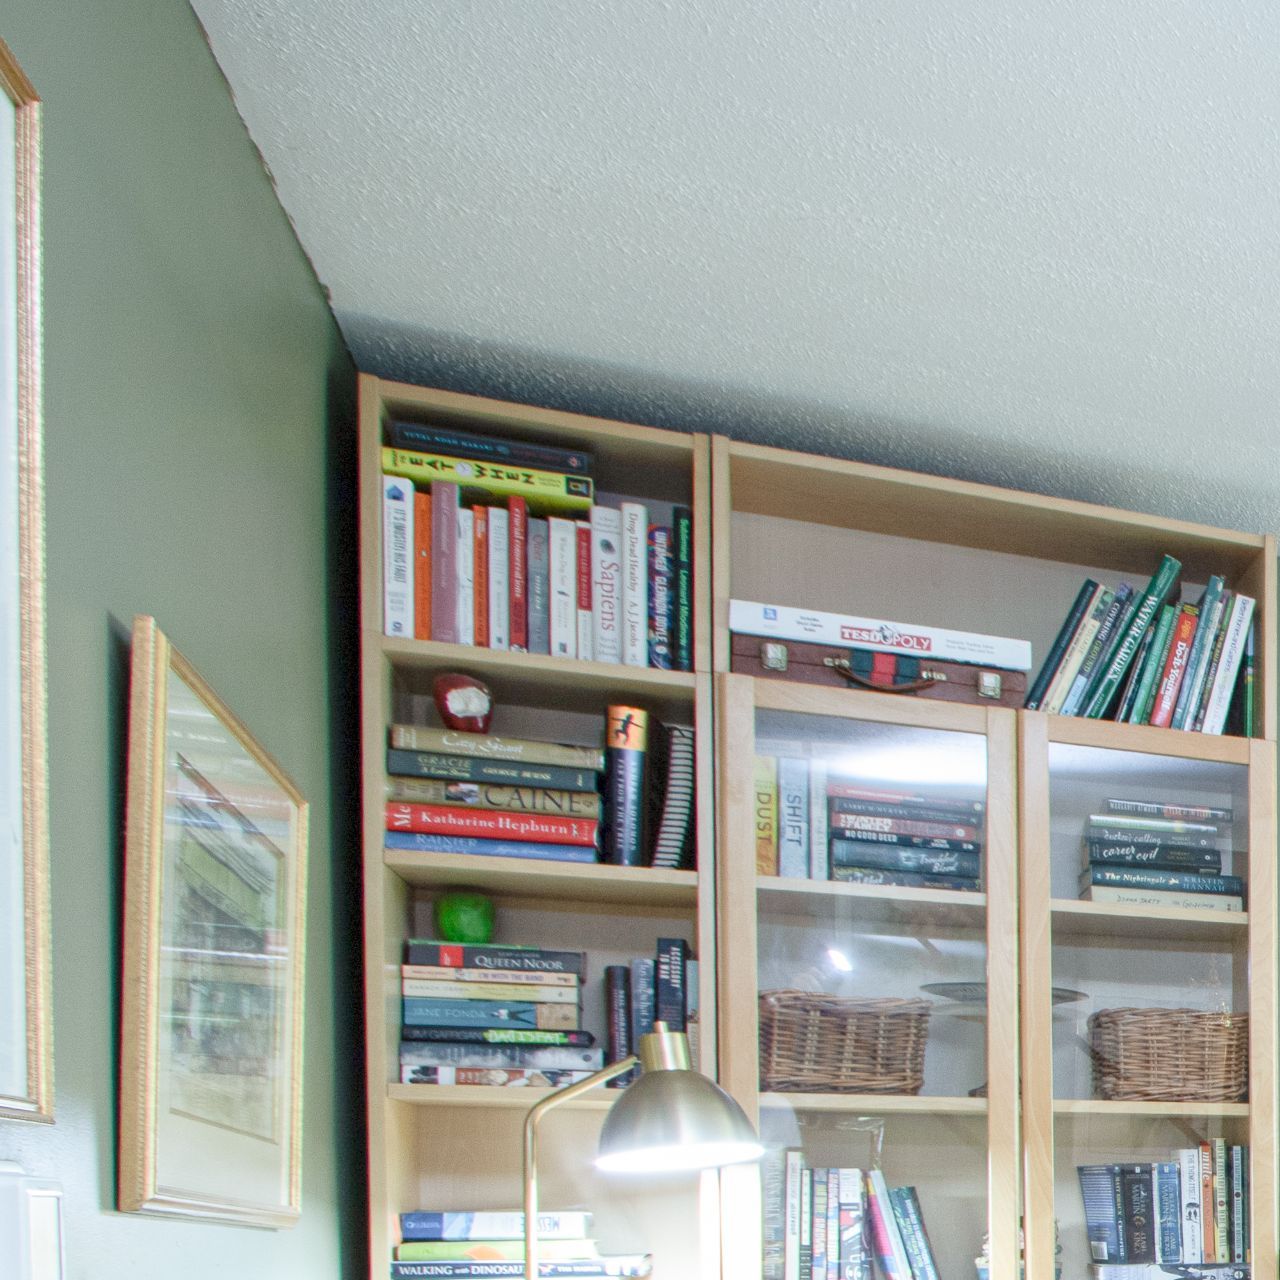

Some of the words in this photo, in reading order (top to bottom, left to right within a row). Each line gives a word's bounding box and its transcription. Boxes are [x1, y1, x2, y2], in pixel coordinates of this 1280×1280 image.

[513, 508, 524, 539] crucial
[627, 512, 638, 534] Drop
[629, 536, 638, 558] Dead
[655, 531, 668, 571] UNTAMED
[680, 518, 689, 562] Subliminal
[512, 539, 523, 598] conversations
[627, 559, 638, 592] Healthy
[595, 560, 620, 632] Sapiens
[655, 576, 668, 614] GLENNON
[679, 569, 688, 605] Leonard
[679, 605, 688, 647] Mlodinow
[1098, 602, 1120, 641] COVERING
[1128, 594, 1158, 633] WATER
[629, 619, 638, 647] Jacobs
[655, 615, 668, 642] DOYLE
[1083, 638, 1102, 674] GROUND
[1106, 629, 1136, 683] GARDEN
[418, 756, 473, 769] GRACIE
[485, 784, 582, 813] CAINE
[392, 804, 412, 828] Me
[420, 812, 495, 828] Katharine
[498, 817, 568, 835] Hepburn
[757, 792, 772, 845] DUST
[787, 794, 802, 847] SHIFT
[1102, 846, 1135, 857] career
[1135, 847, 1159, 861] evil
[1104, 872, 1120, 880] The
[1122, 873, 1166, 884] Nightingale
[1182, 883, 1224, 892] HANNAH
[1183, 876, 1224, 885] KRISTIN
[474, 954, 522, 968] QUEEN
[524, 958, 564, 970] NOOR
[659, 964, 669, 980] WAR
[670, 946, 681, 988] ACCESSORY
[412, 1008, 441, 1017] JANE
[444, 1009, 488, 1018] FONDA
[1202, 1151, 1211, 1180] mule
[399, 1265, 453, 1276] WALKING
